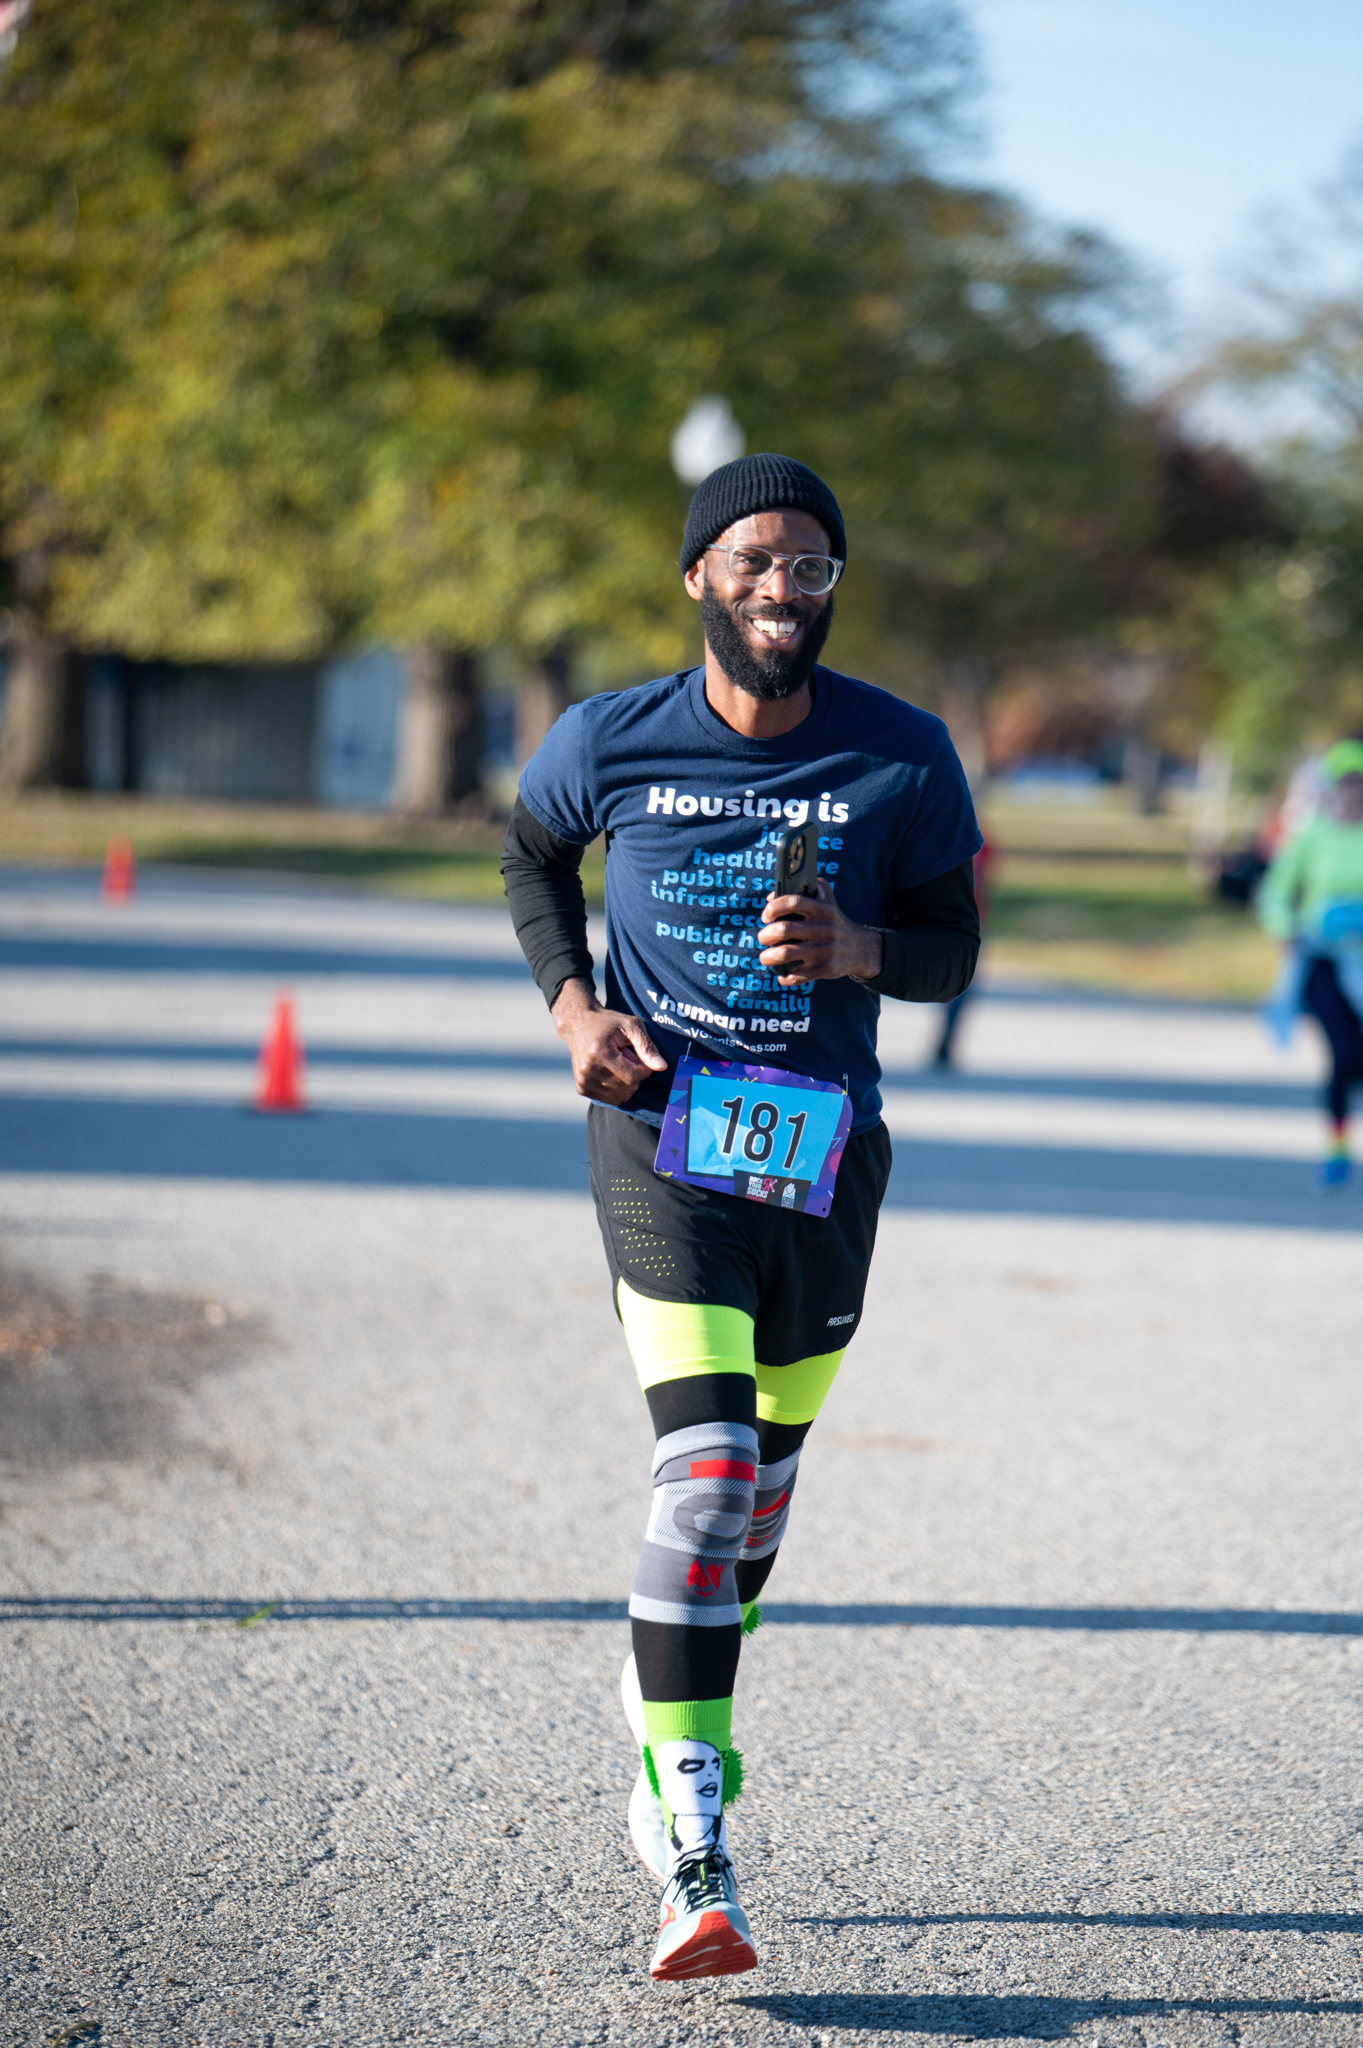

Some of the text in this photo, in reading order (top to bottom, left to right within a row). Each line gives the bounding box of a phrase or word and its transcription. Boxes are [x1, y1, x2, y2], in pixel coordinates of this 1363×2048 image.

[647, 786, 850, 827] Housing is
[755, 825, 844, 850] juce
[693, 848, 839, 875] healthre
[662, 869, 746, 890] public
[656, 921, 734, 946] public
[660, 994, 746, 1031] human
[750, 1017, 811, 1033] need
[727, 990, 811, 1016] family
[721, 1095, 807, 1170] 181
[746, 1186, 768, 1198] SOCKS
